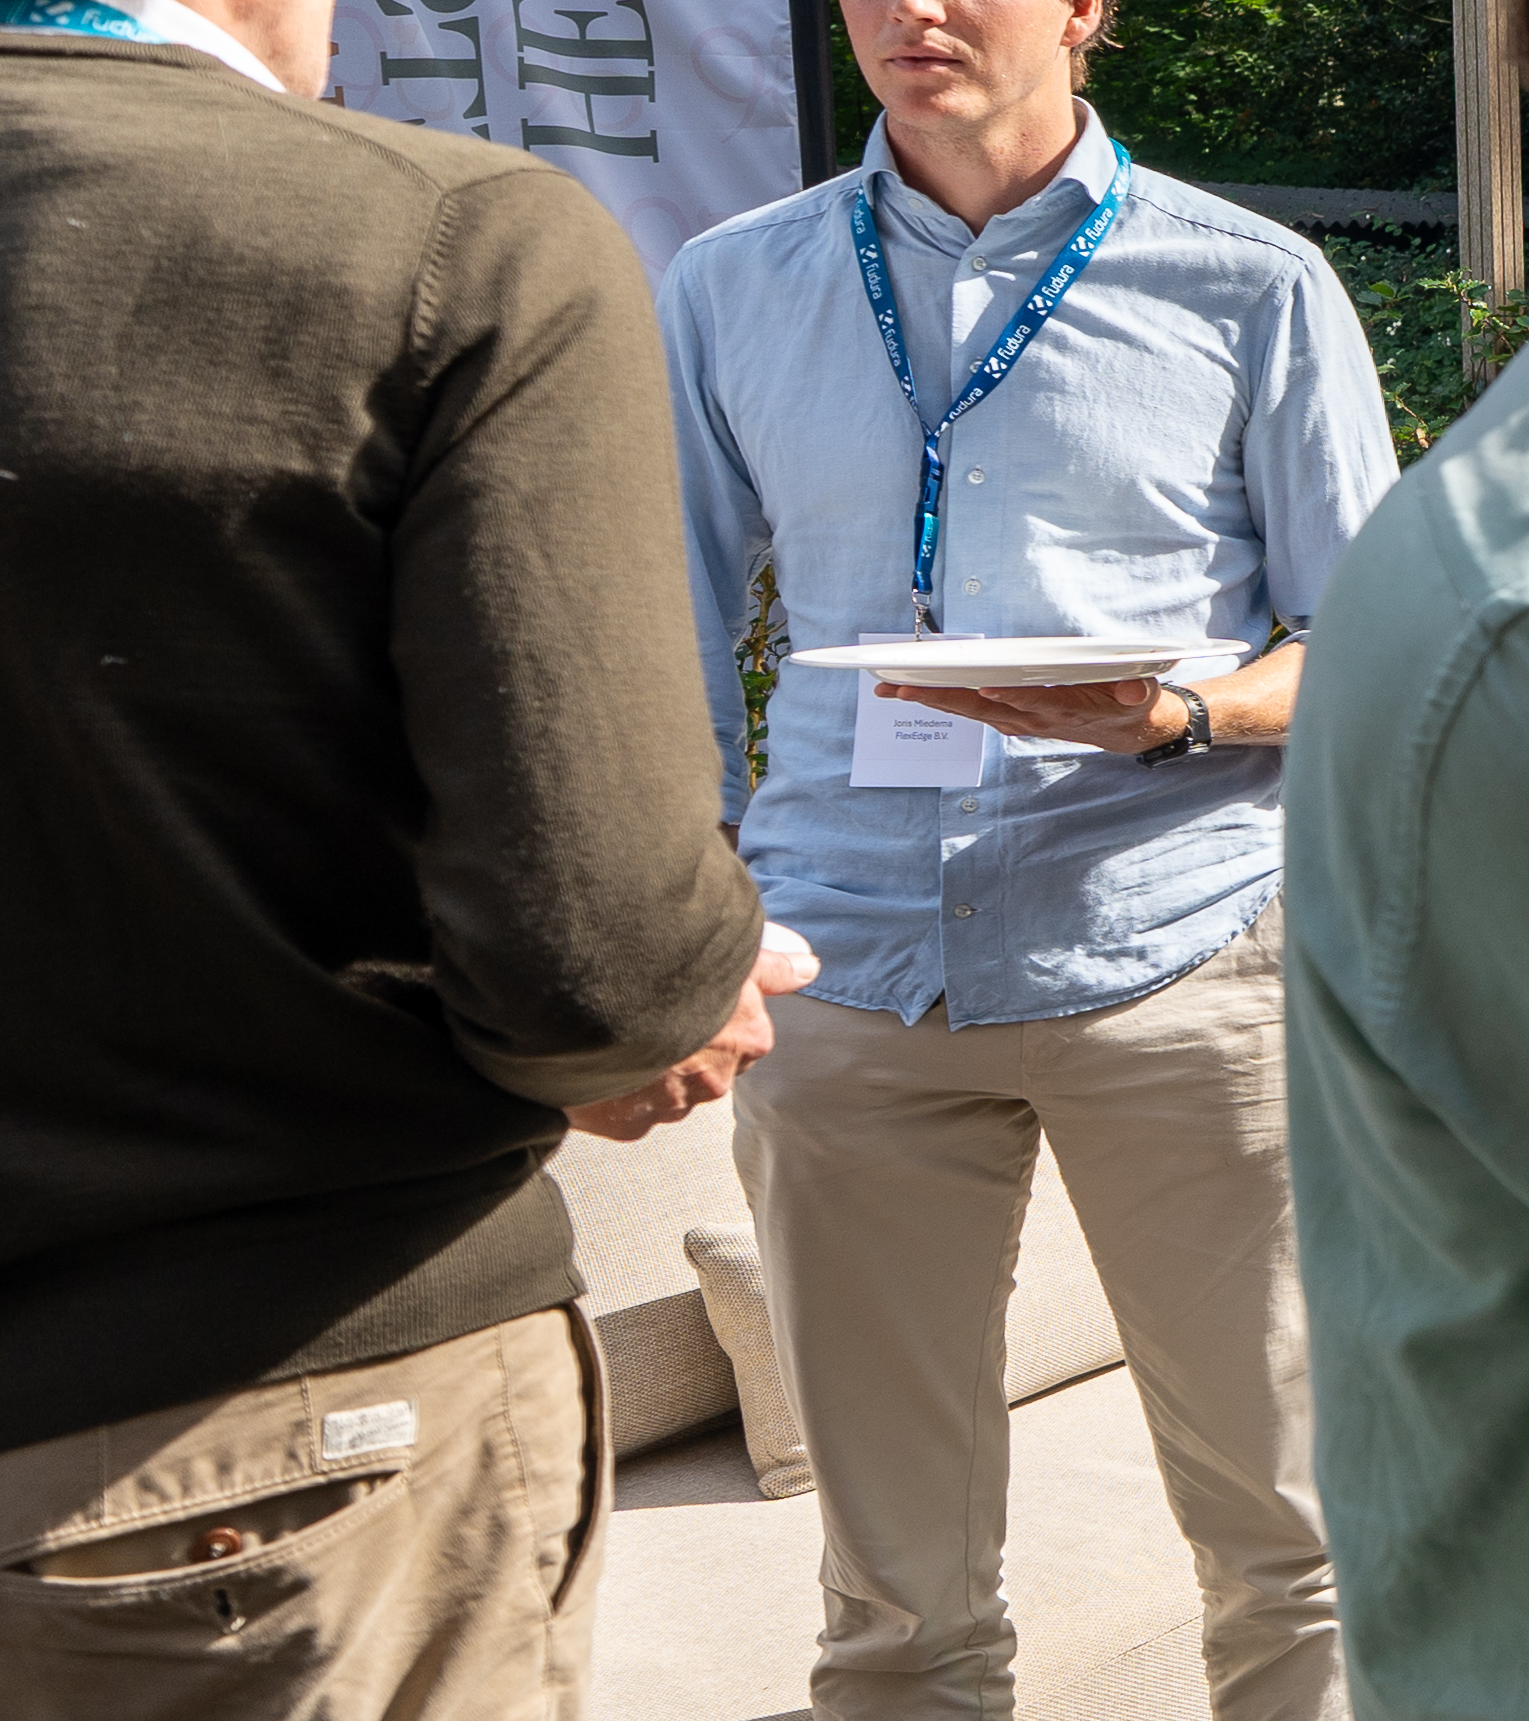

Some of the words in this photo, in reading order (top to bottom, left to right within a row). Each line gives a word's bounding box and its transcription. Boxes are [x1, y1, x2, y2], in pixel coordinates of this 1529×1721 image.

[1085, 207, 1113, 244] fudura
[866, 263, 882, 300] fudura
[1042, 264, 1074, 299] fudura
[884, 328, 902, 367] fudura
[997, 324, 1031, 360] fudura
